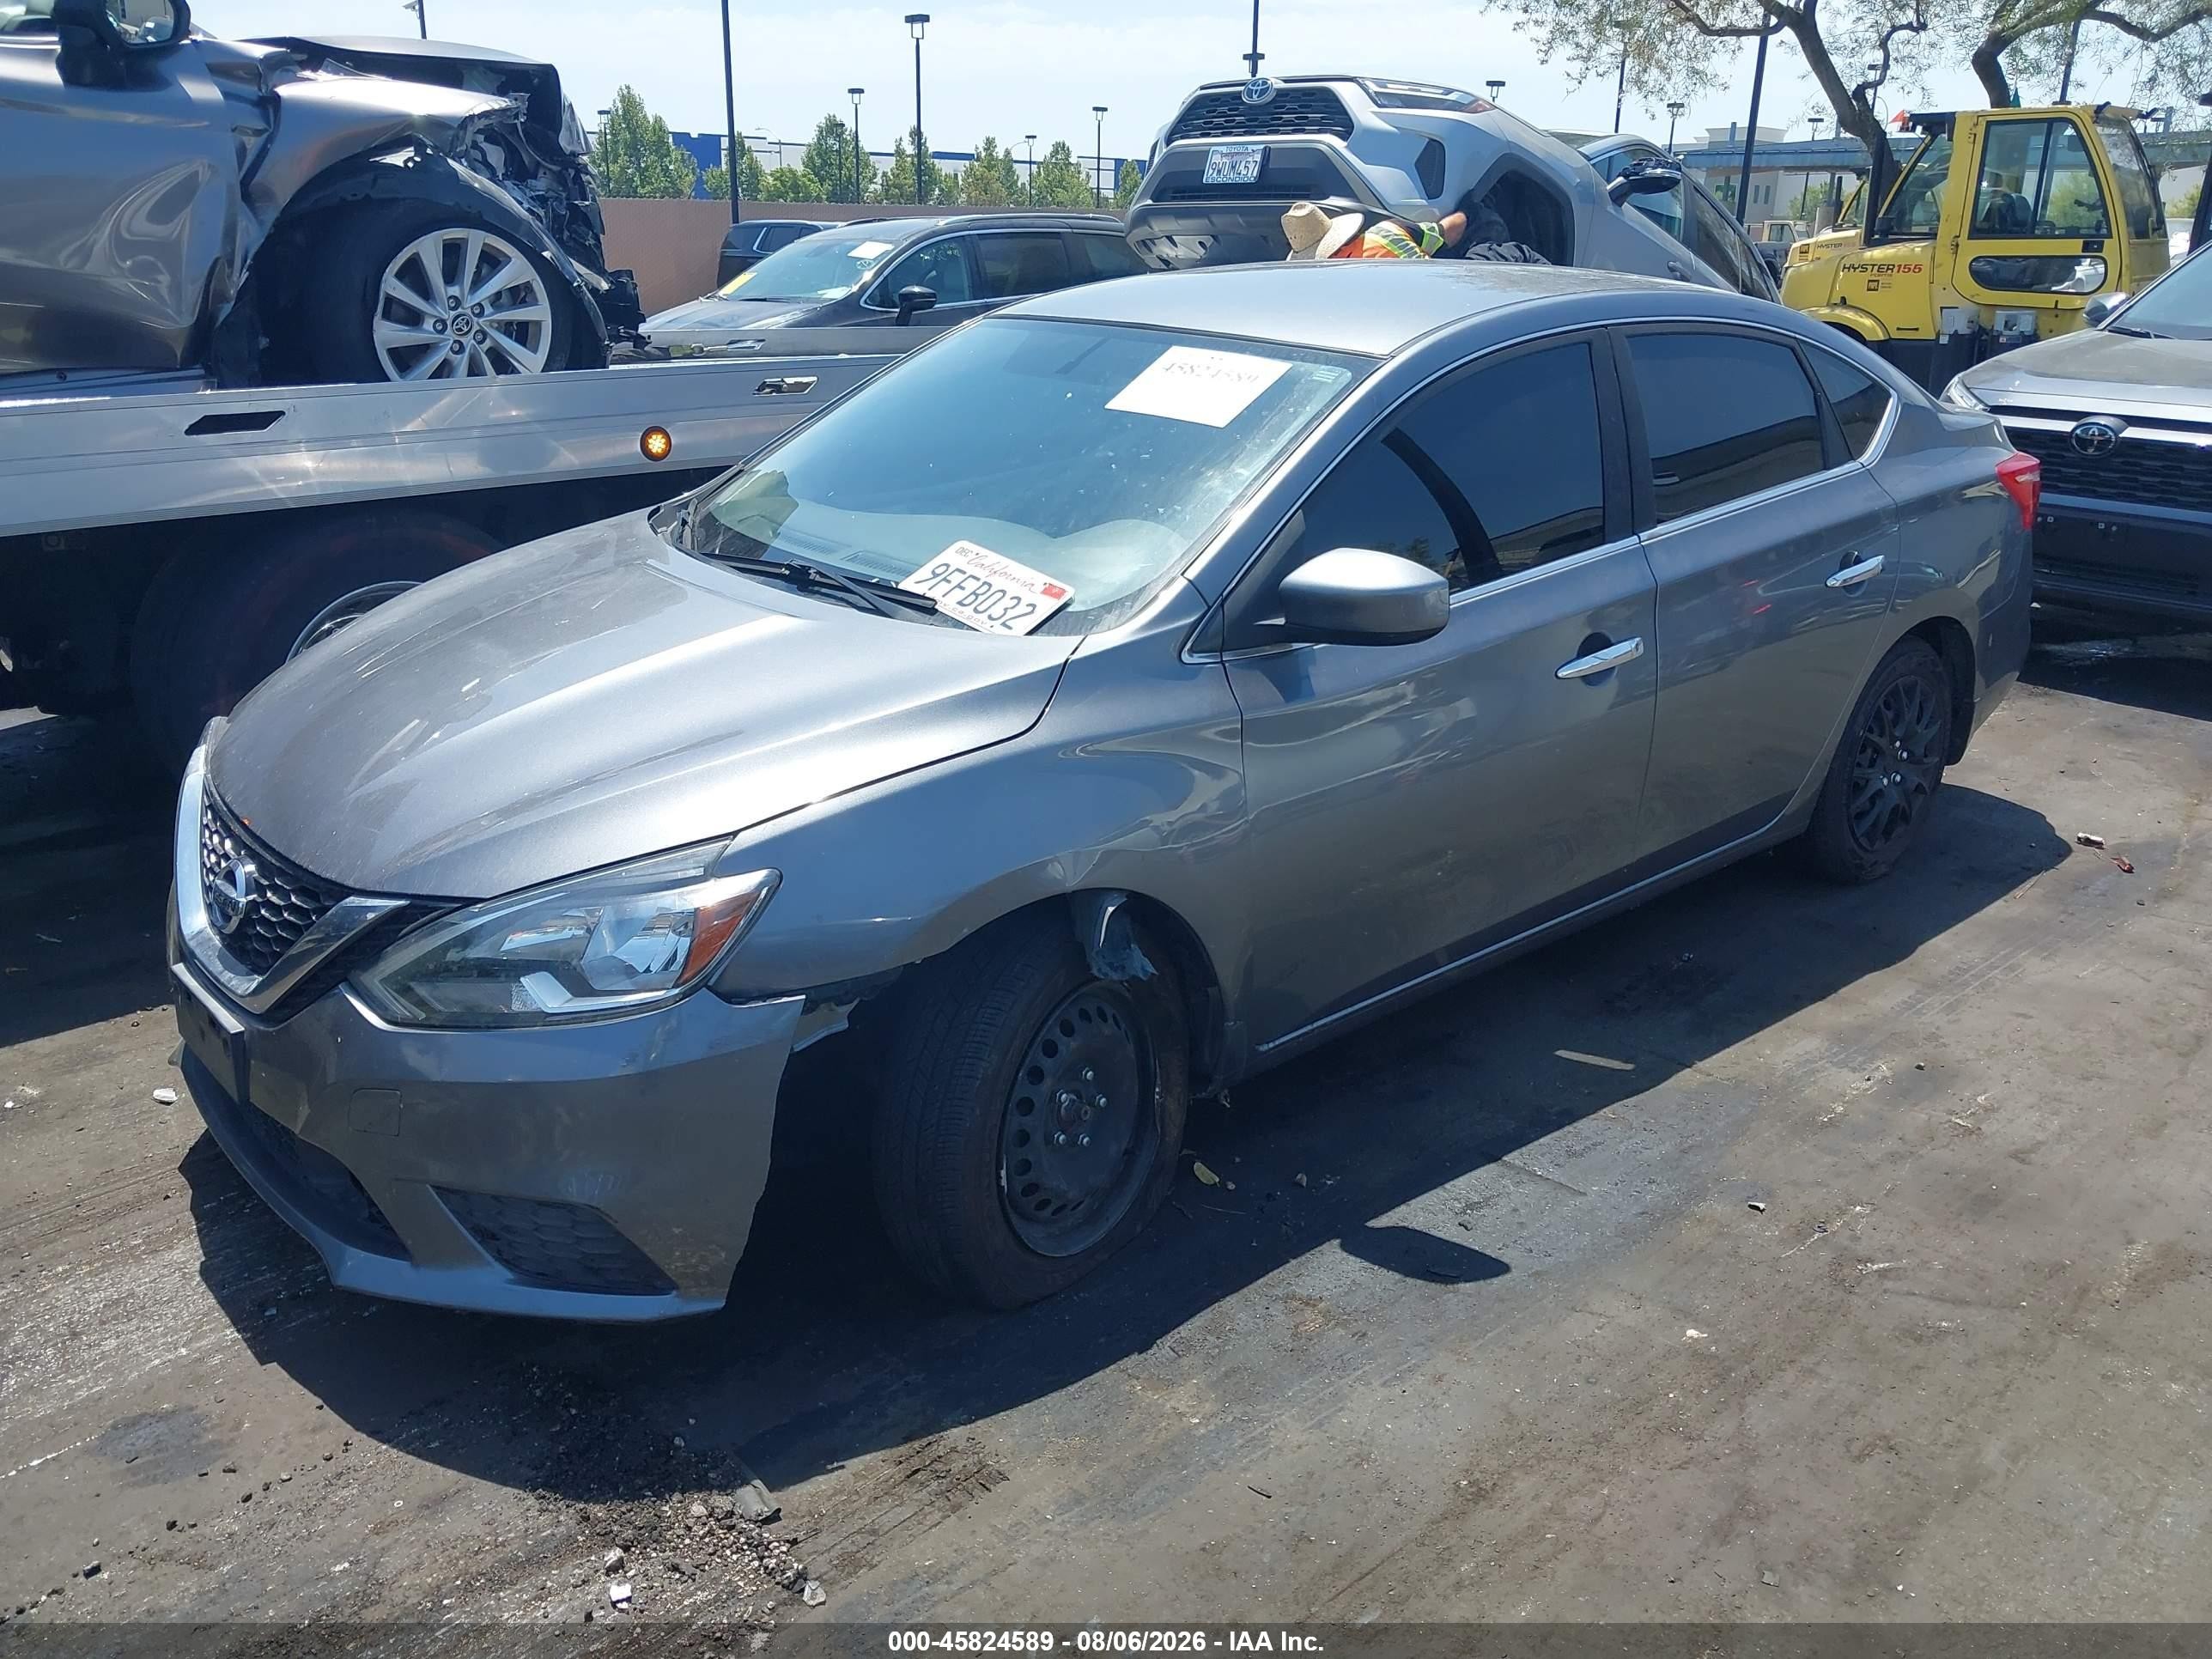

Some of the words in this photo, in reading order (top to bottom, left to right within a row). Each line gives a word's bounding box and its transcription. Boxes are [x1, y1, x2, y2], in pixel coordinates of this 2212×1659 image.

[1842, 264, 1895, 273] HYSTER
[1896, 264, 1923, 274] 155
[967, 555, 1038, 594] California
[914, 562, 1037, 630] 9FFB032
